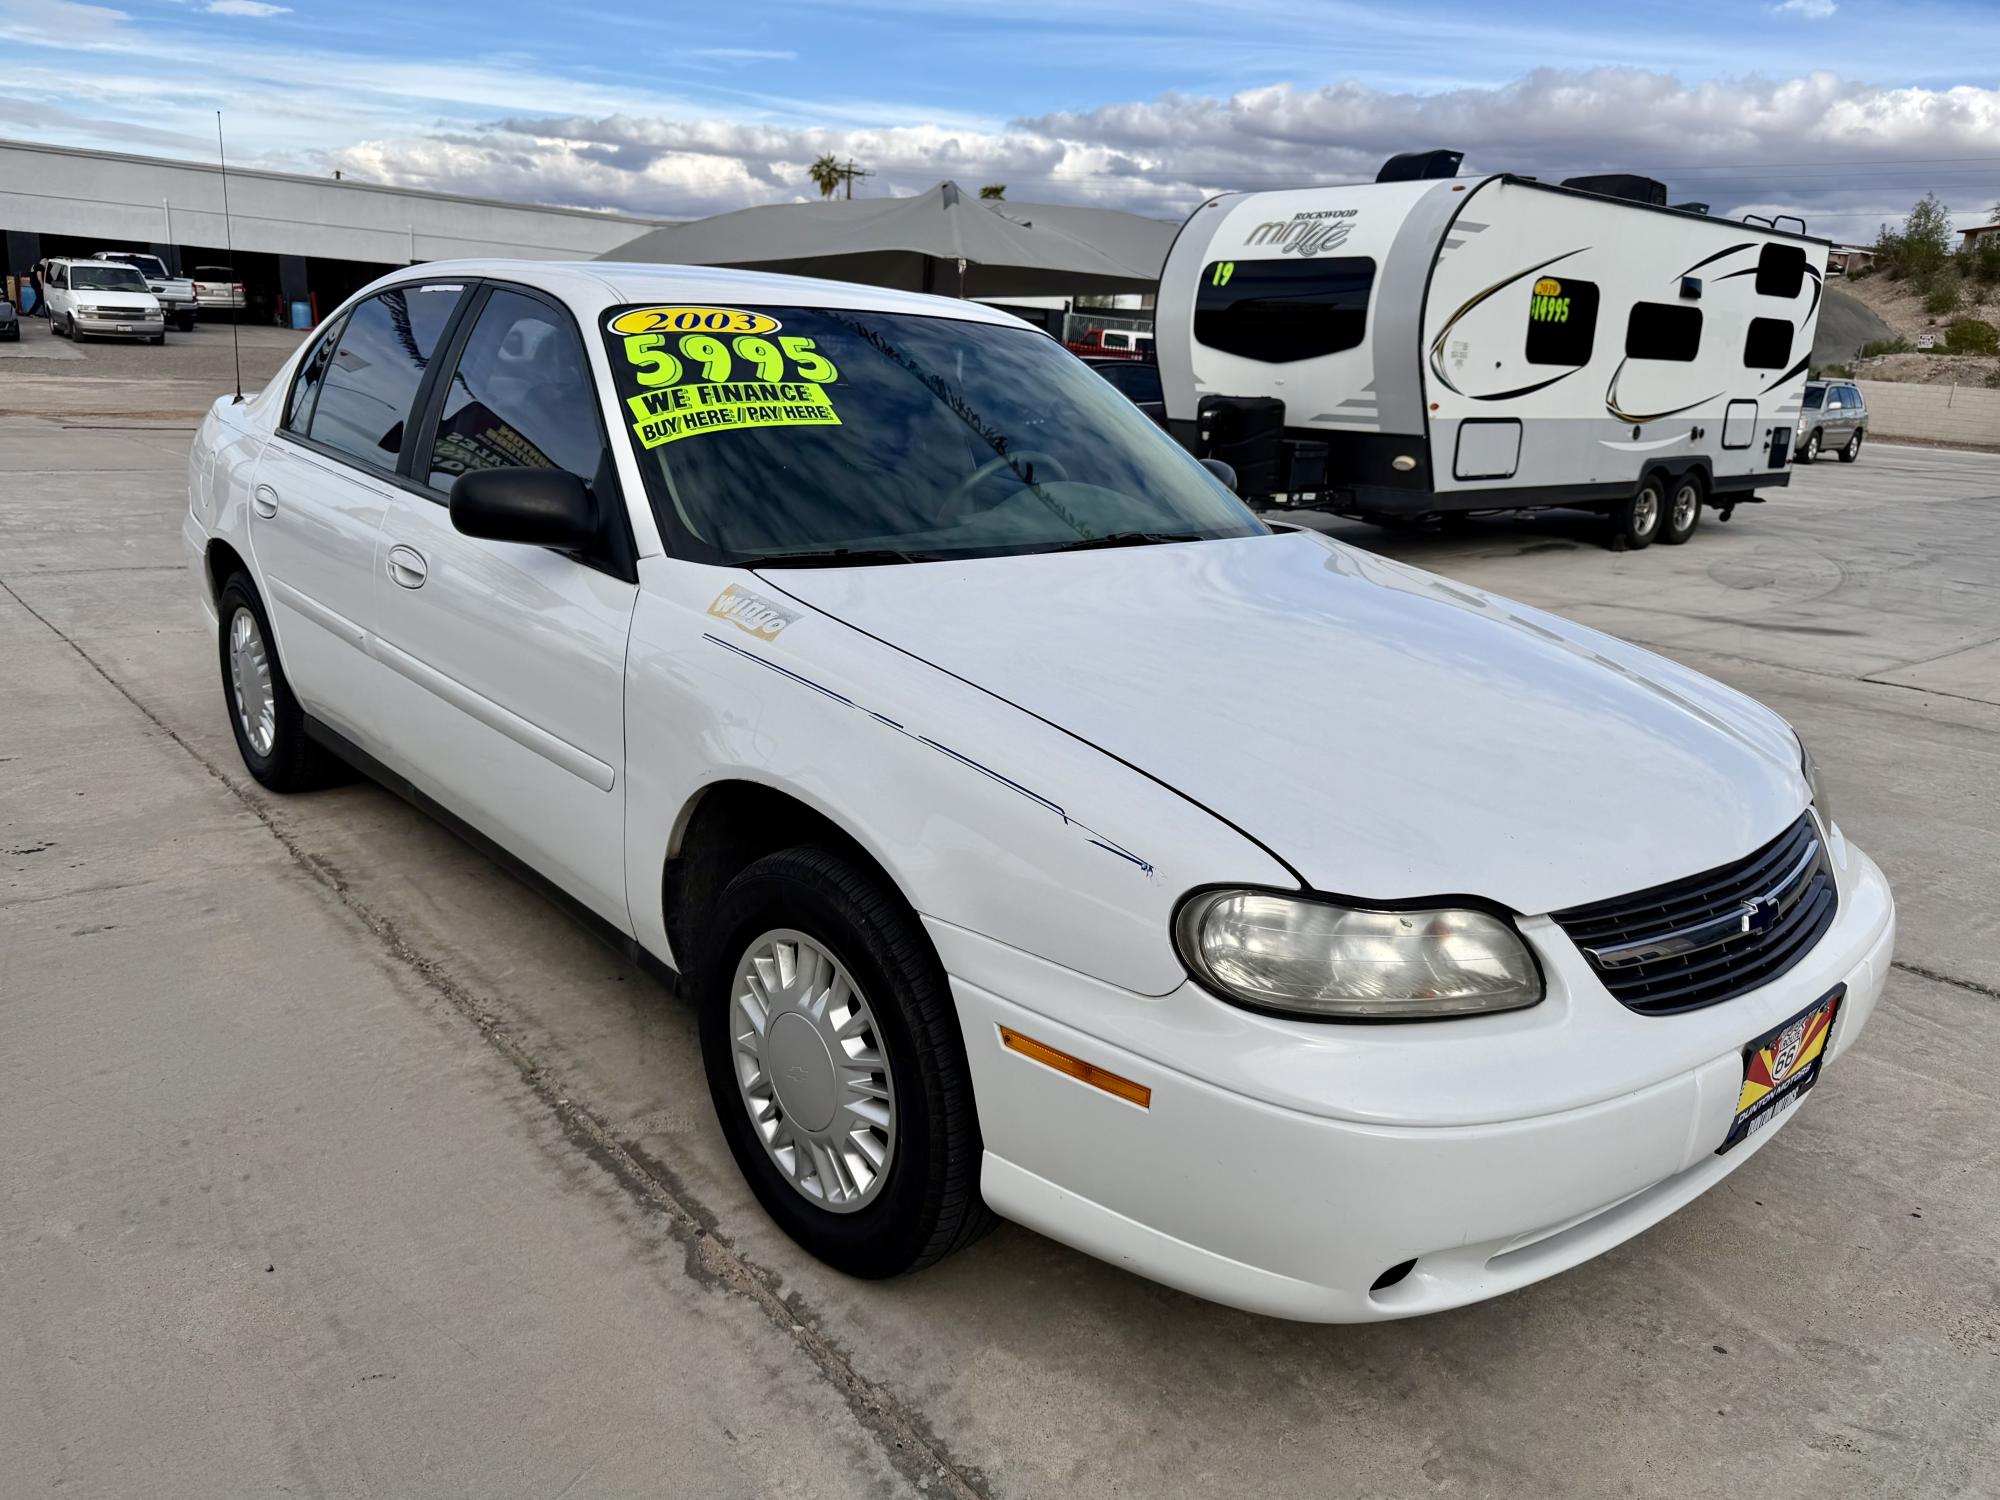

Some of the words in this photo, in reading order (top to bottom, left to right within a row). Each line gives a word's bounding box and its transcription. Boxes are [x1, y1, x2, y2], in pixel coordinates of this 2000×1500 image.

[1293, 209, 1359, 220] ROCKWOOD
[1212, 261, 1235, 287] 19
[1540, 283, 1558, 294] 2019
[643, 312, 757, 331] 2003
[623, 333, 839, 387] 5995
[641, 388, 692, 415] WE
[697, 384, 812, 405] FINANCE
[642, 417, 680, 442] BUY
[684, 408, 735, 429] HERE
[749, 406, 781, 421] PAY
[785, 405, 831, 420] HERE
[1775, 1045, 1796, 1075] 66
[1738, 1089, 1776, 1124] DUNTON
